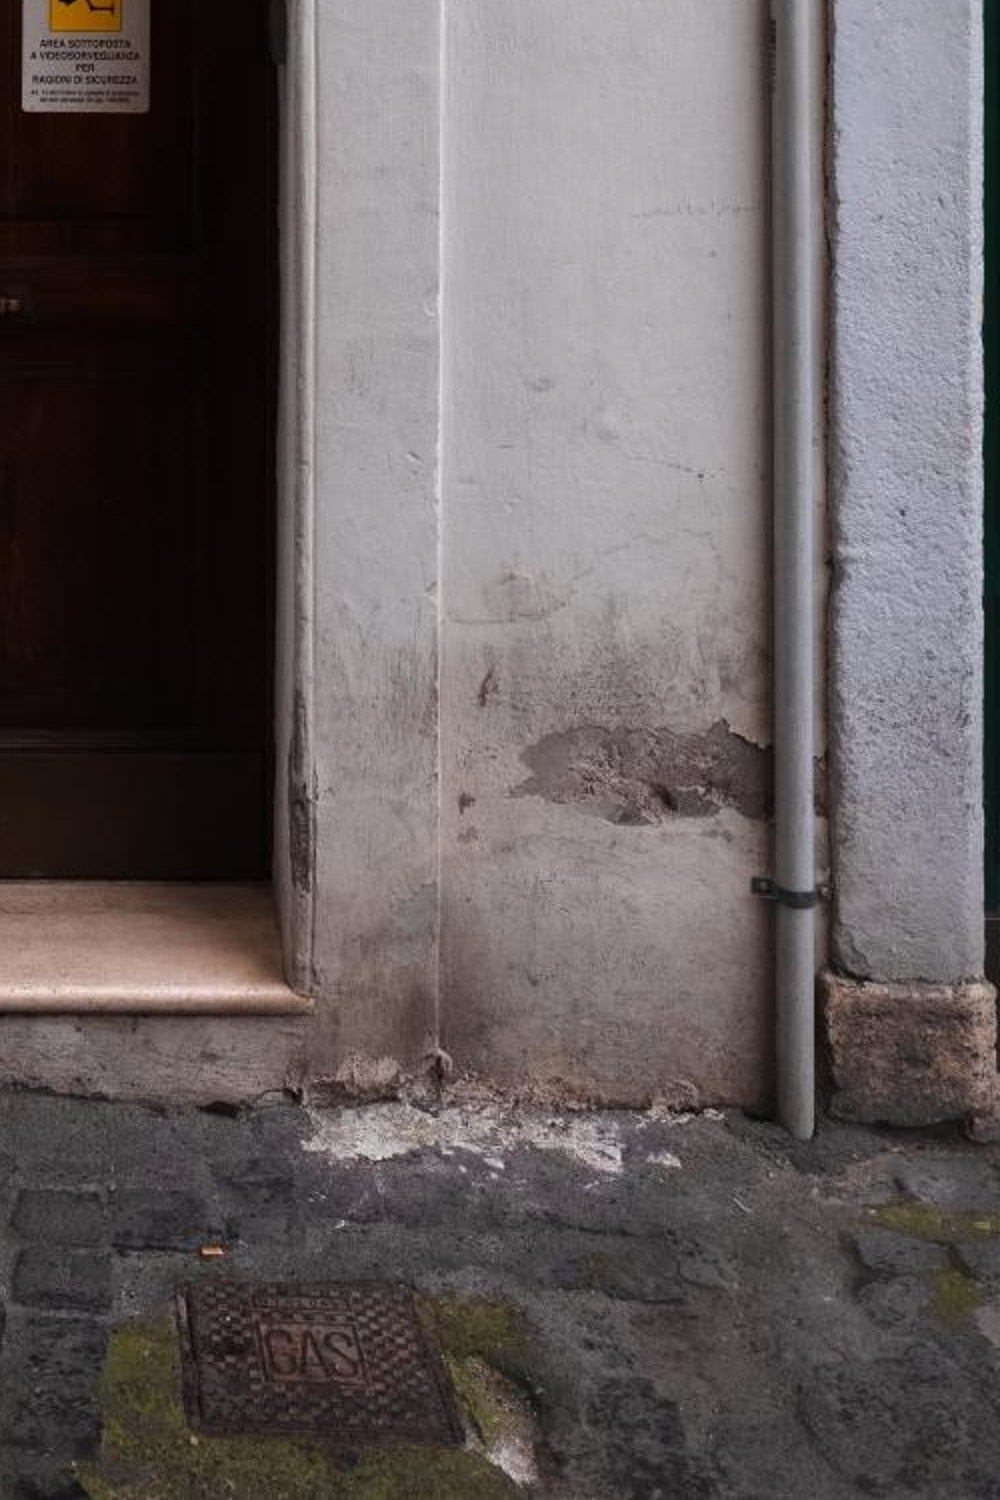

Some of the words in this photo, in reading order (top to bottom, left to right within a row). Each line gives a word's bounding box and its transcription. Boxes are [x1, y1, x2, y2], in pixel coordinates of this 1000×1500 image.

[40, 39, 65, 49] AREA
[67, 39, 131, 49] SOTTOPOSTA
[30, 52, 37, 61] A
[75, 64, 95, 73] PER
[32, 76, 71, 85] RAGIONI
[73, 76, 83, 85] DI
[85, 76, 137, 85] SICUREZZA
[264, 1329, 359, 1378] GAS
